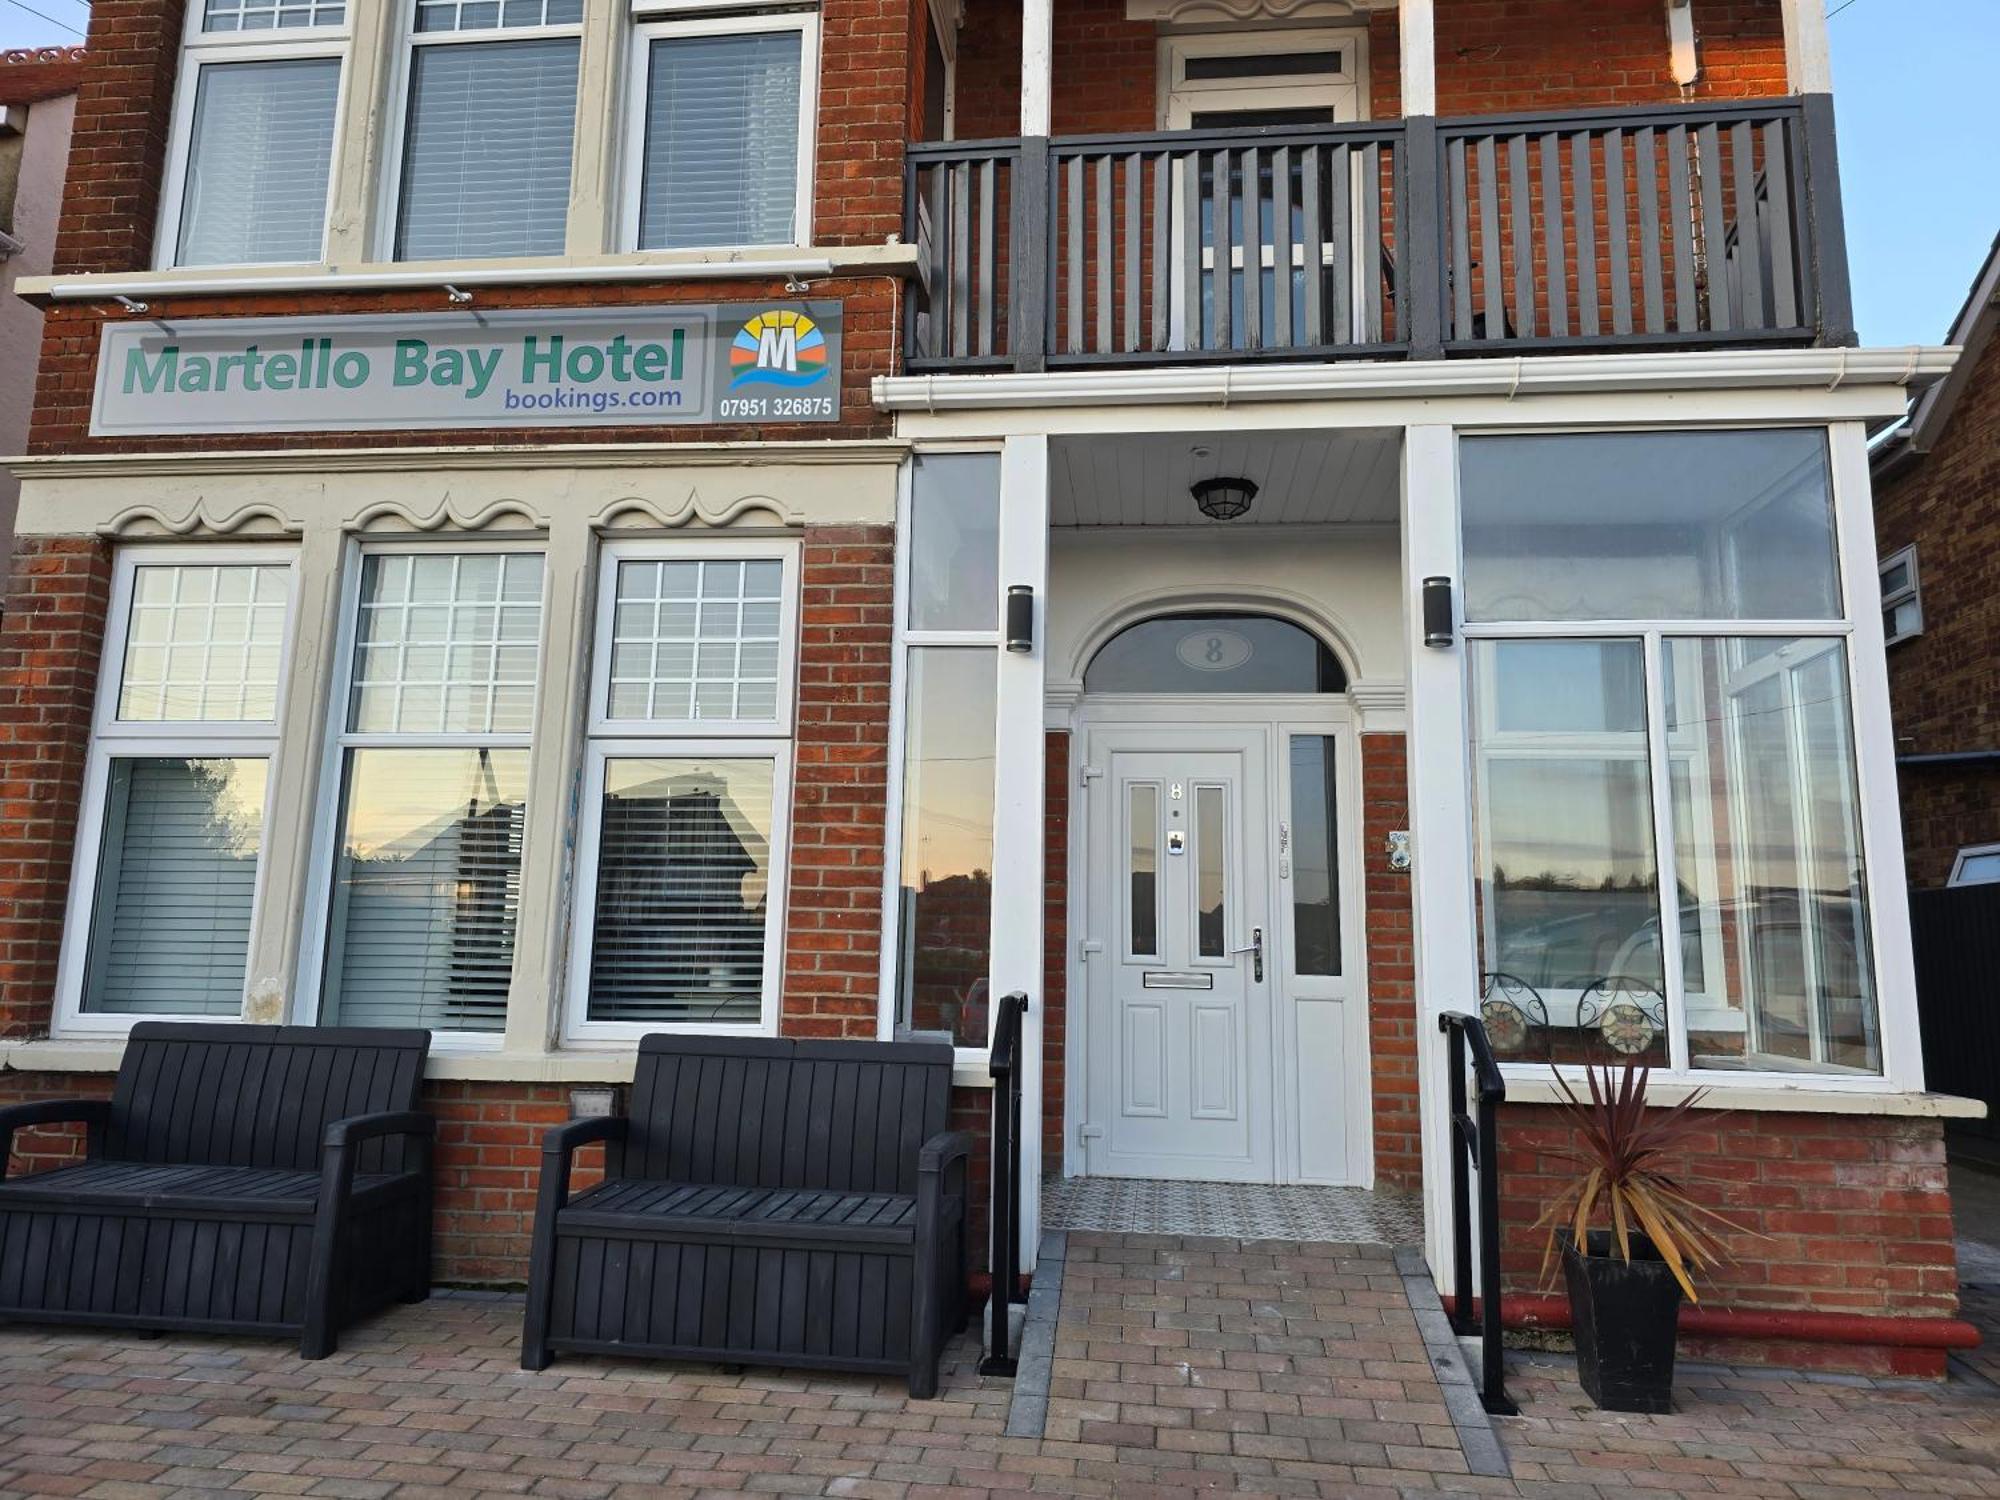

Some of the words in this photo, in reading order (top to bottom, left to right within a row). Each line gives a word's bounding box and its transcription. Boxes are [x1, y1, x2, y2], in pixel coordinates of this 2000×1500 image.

[756, 327, 797, 371] M
[122, 338, 370, 394] Martello
[393, 339, 503, 399] Bay
[522, 329, 685, 384] Hotel
[505, 388, 681, 412] bookings.com
[720, 399, 767, 417] 07951
[773, 398, 832, 416] 326875
[1206, 638, 1223, 663] 8
[1171, 783, 1182, 800] 8
